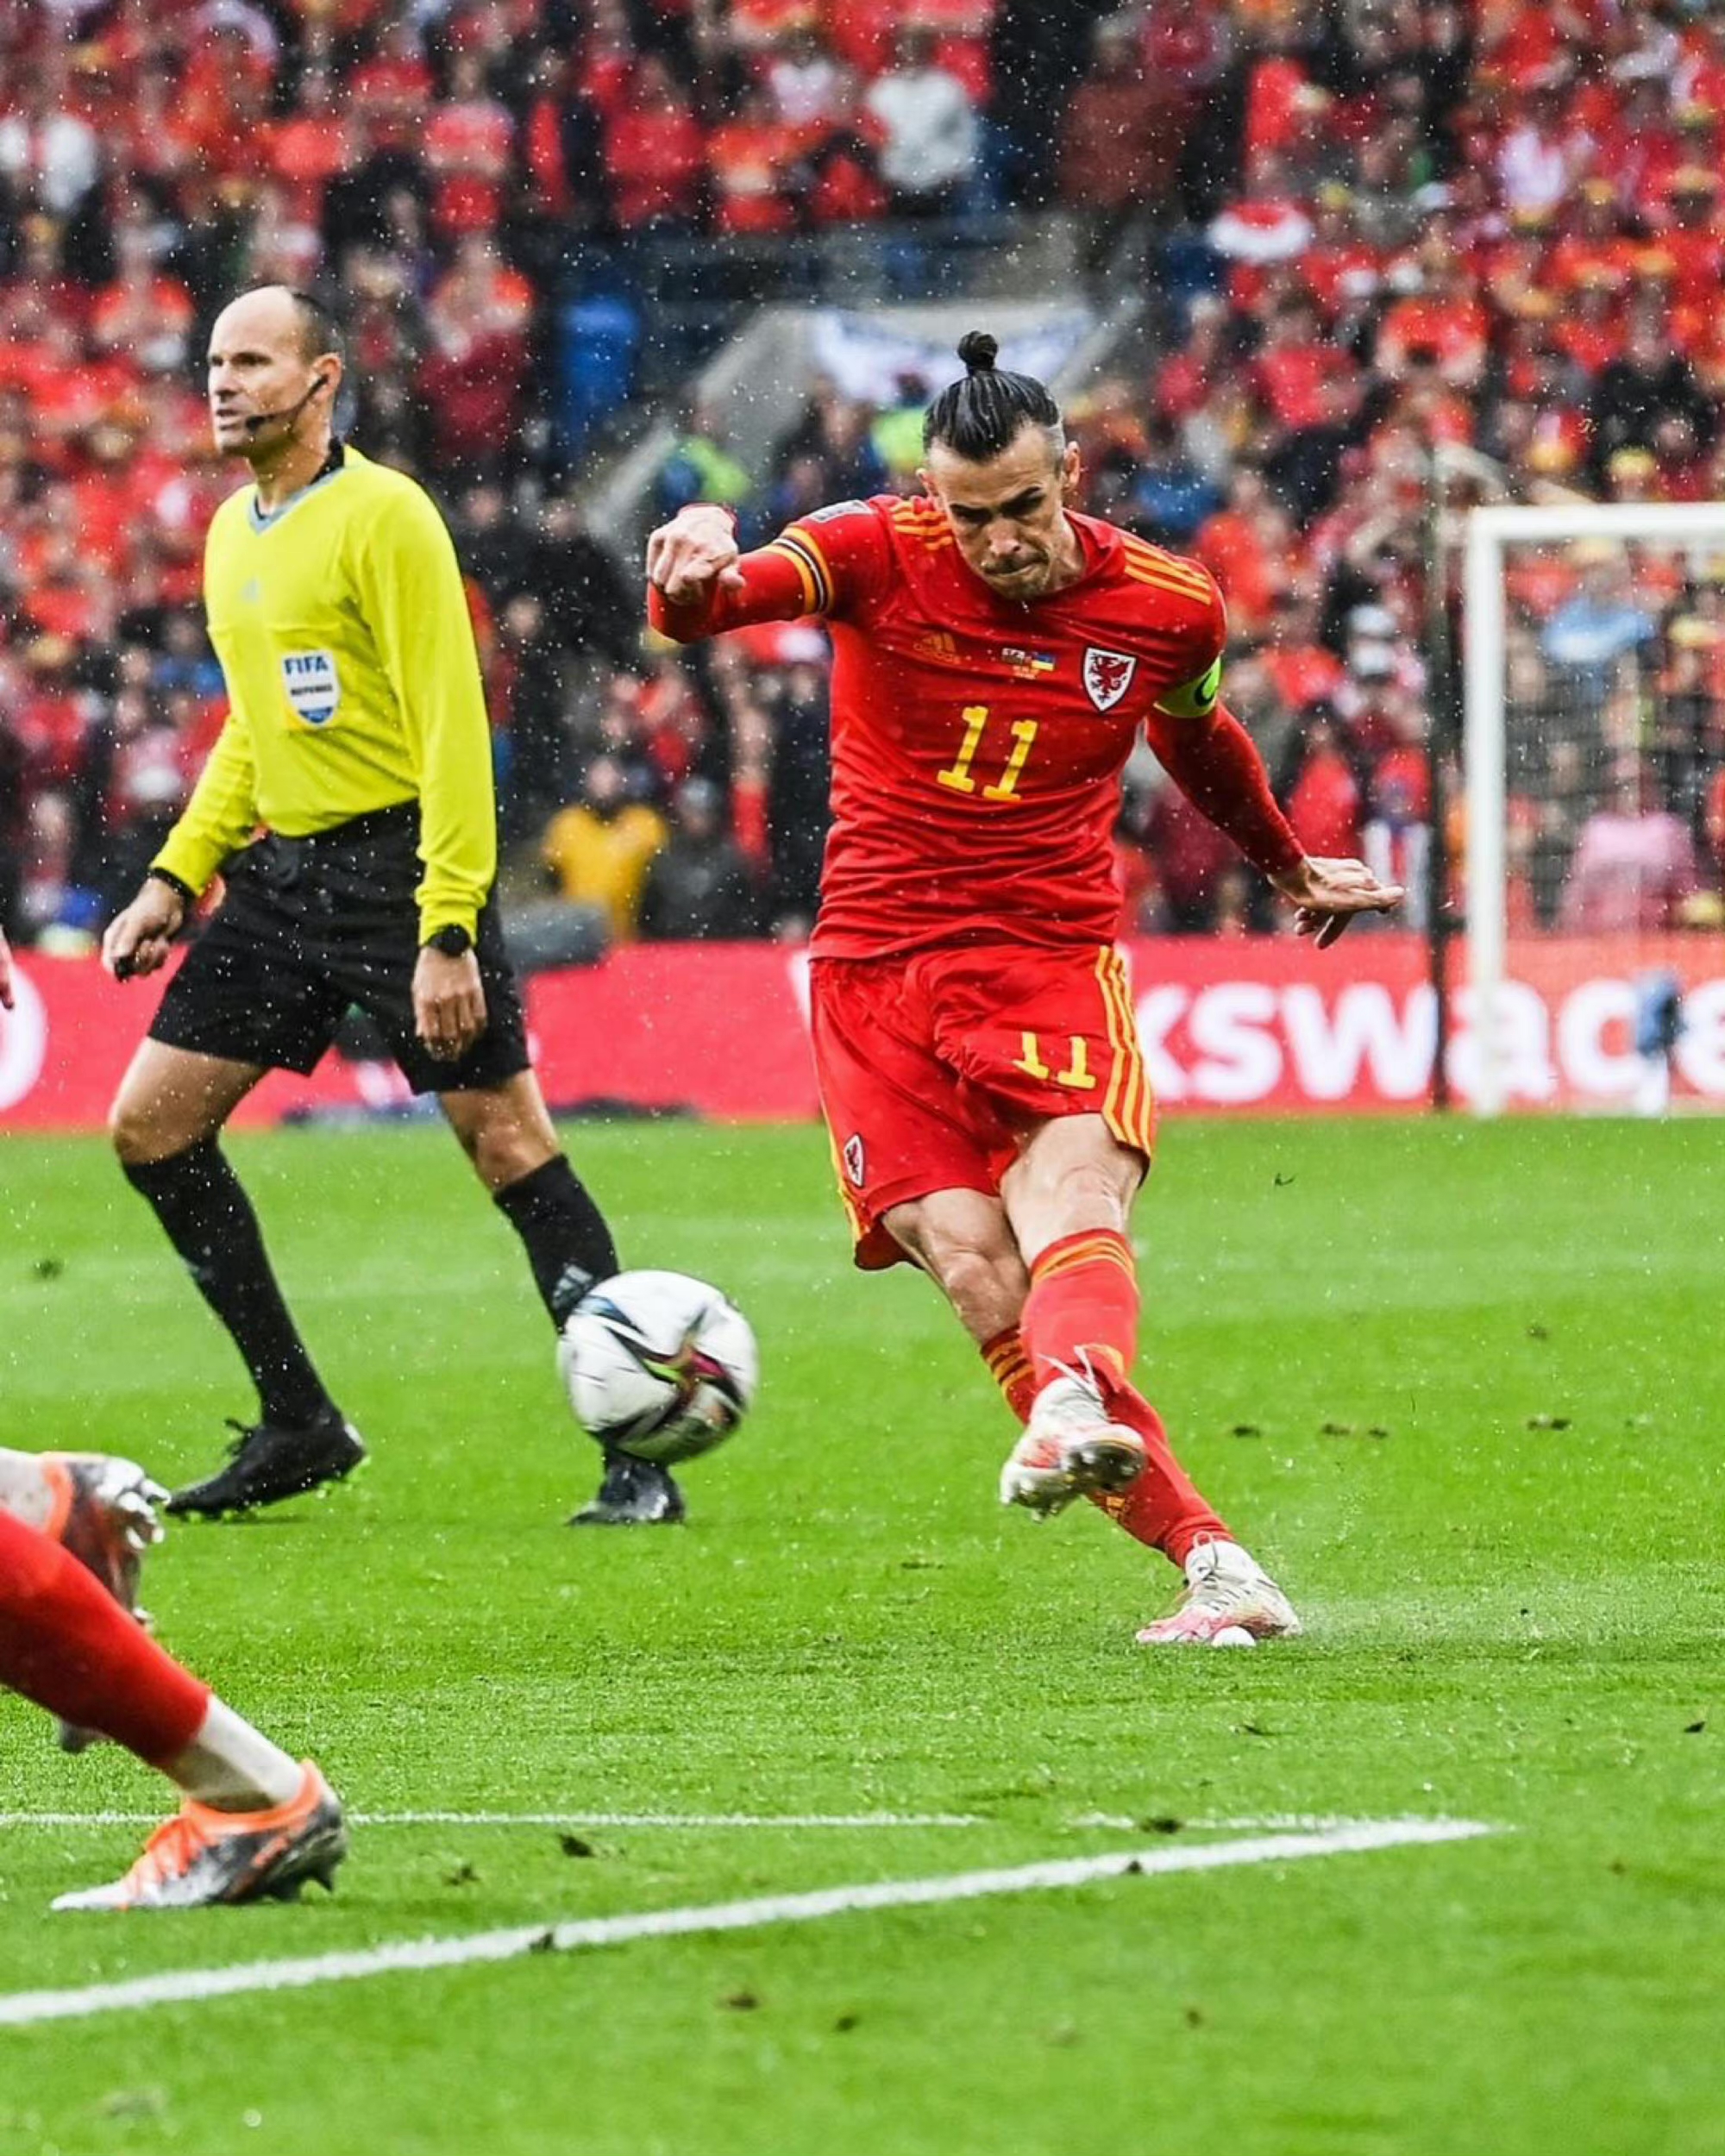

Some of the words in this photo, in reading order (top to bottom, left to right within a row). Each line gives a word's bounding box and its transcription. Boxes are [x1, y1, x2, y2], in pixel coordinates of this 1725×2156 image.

[284, 655, 329, 675] FIFA
[937, 705, 1038, 802] 11
[1012, 1031, 1096, 1089] 11
